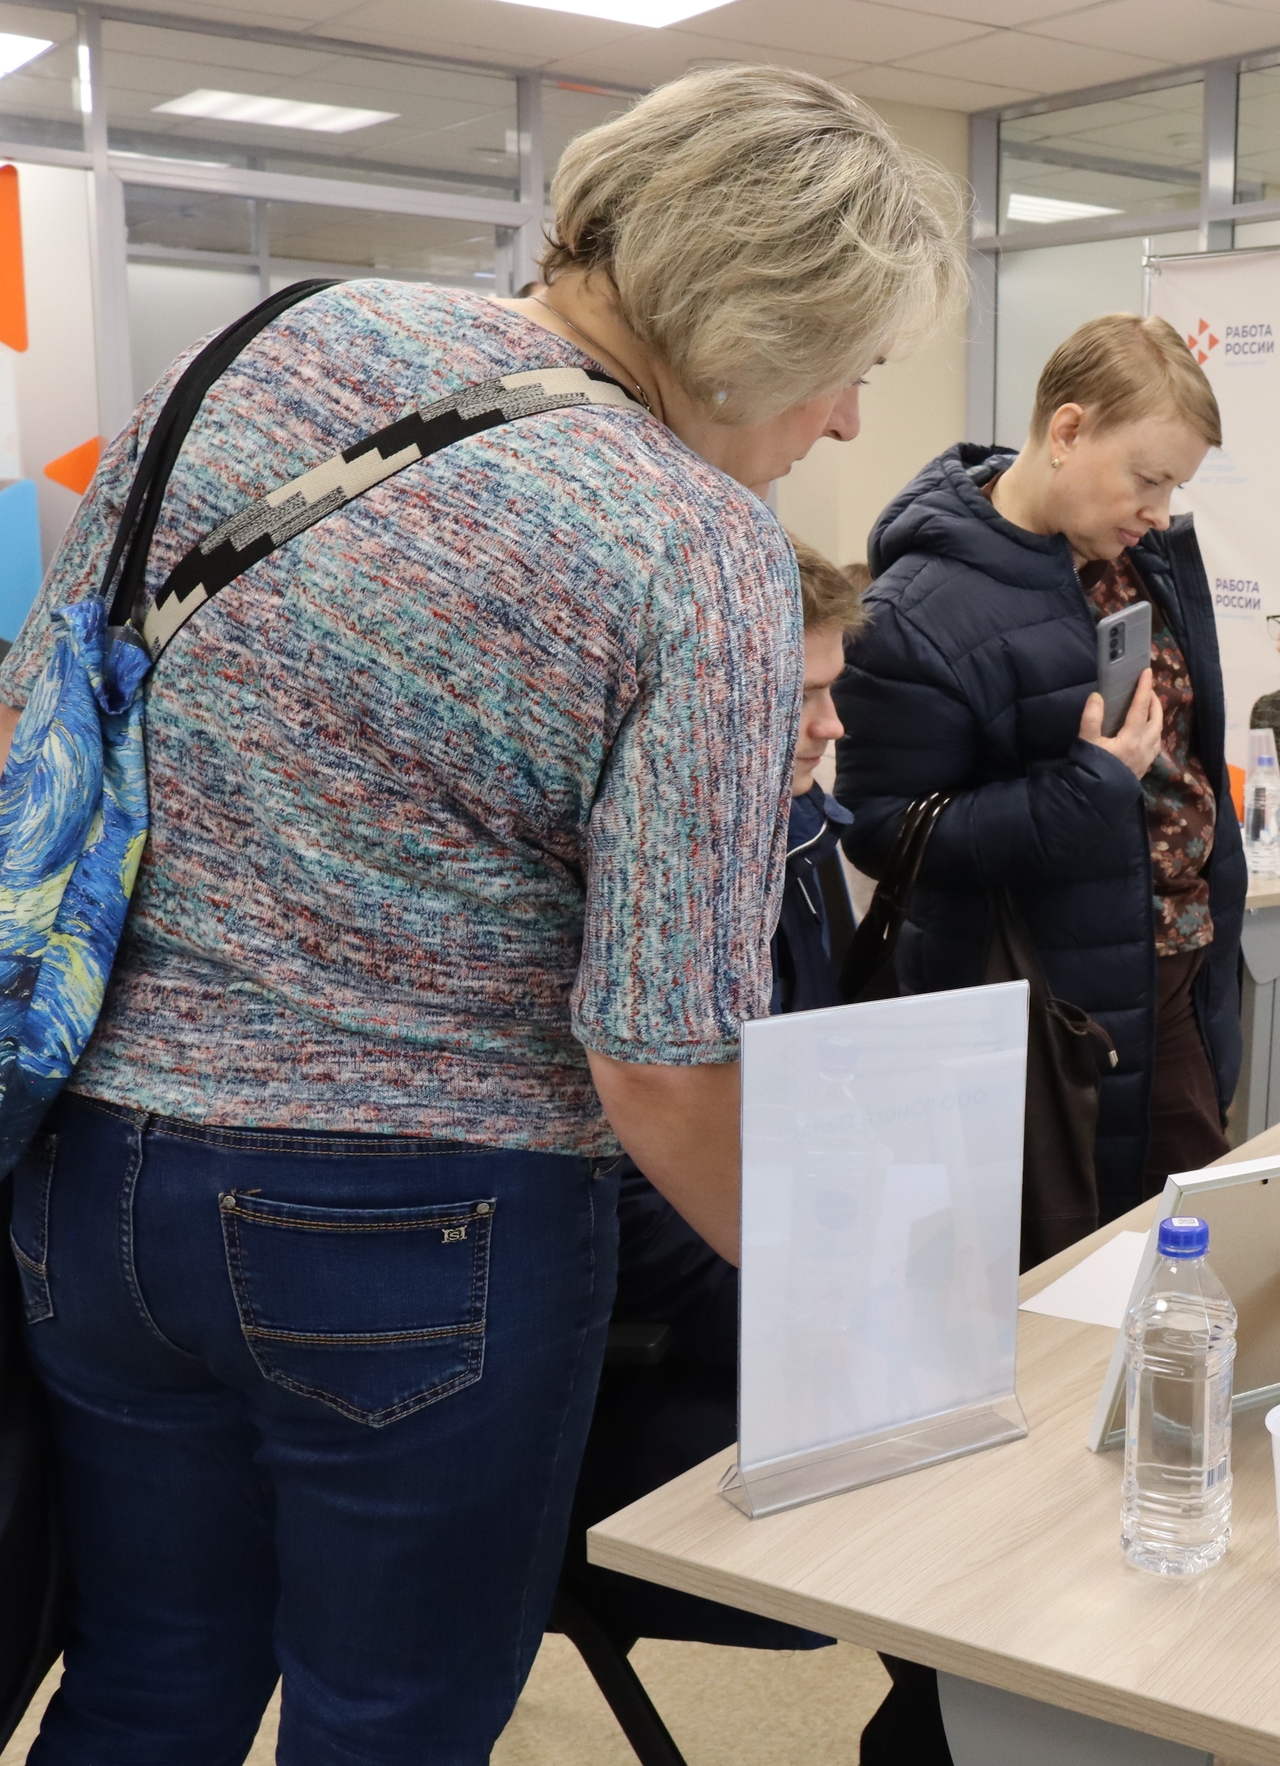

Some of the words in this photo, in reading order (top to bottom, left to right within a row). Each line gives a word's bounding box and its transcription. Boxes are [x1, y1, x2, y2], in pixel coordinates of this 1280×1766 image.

[1226, 324, 1272, 338] РАБОТА
[1225, 341, 1274, 355] РОССИИ
[1216, 578, 1259, 592] РАБОТА
[1215, 594, 1261, 610] РОССИИ
